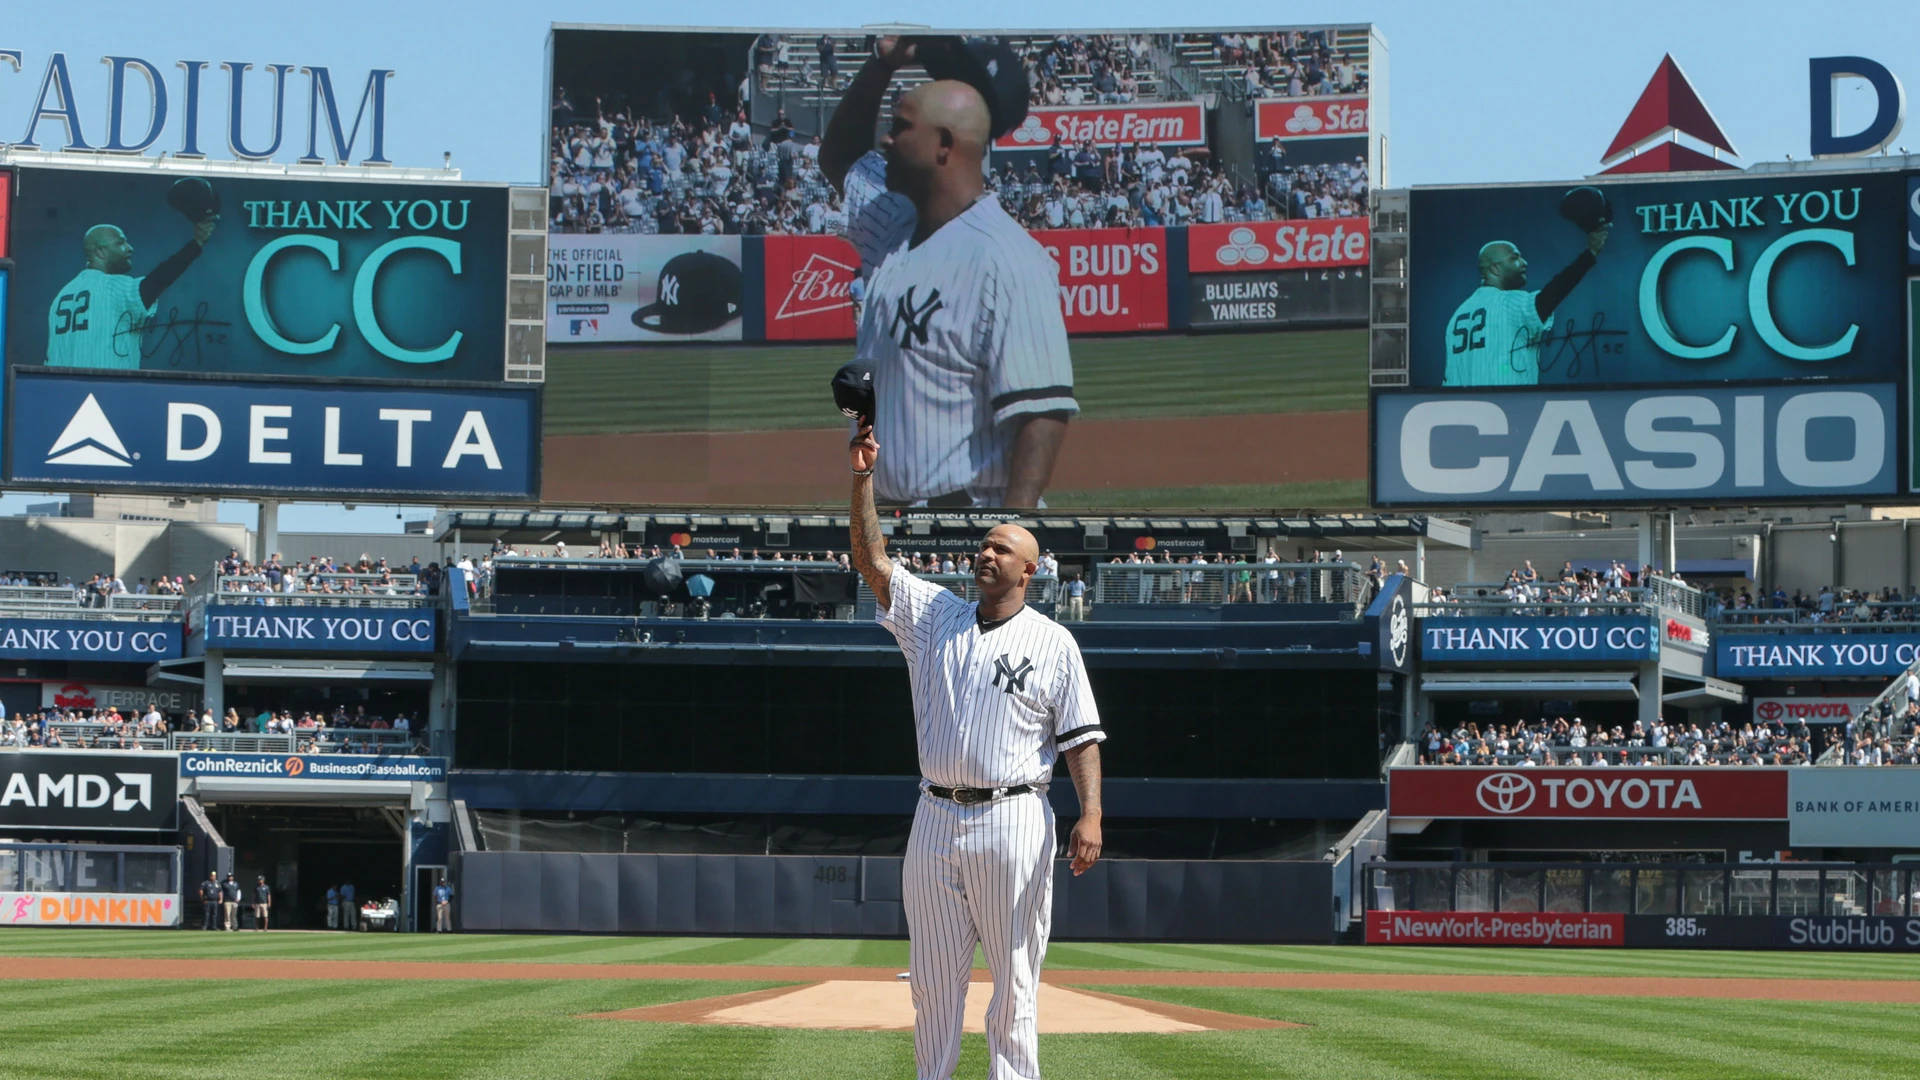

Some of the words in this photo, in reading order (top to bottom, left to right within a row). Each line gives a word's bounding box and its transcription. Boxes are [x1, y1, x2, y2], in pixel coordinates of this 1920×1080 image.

[1325, 104, 1369, 131] Sta
[243, 200, 371, 230] THANK
[379, 200, 471, 230] YOU
[1636, 196, 1764, 233] THANK
[1774, 188, 1862, 223] YOU
[573, 249, 622, 261] OFFICIAL
[1273, 225, 1365, 263] State
[1070, 242, 1159, 277] BUD'S
[243, 234, 463, 363] CC
[550, 285, 573, 297] CAP
[577, 285, 590, 297] OF
[1206, 281, 1279, 300] BLUEJAYS
[1638, 228, 1860, 361] CC
[55, 289, 91, 335] 52
[1211, 302, 1277, 321] YANKEES
[1452, 307, 1487, 355] 52
[166, 402, 502, 470] DELTA
[1400, 391, 1885, 493] CASIO
[889, 538, 936, 546] mastercard
[1157, 539, 1204, 547] mastercard
[0, 628, 60, 650] ANK
[67, 630, 124, 651] YOU
[131, 632, 167, 652] CC
[212, 616, 315, 638] THANK
[322, 618, 384, 640] YOU
[391, 619, 430, 641] CC
[1427, 628, 1529, 650] THANK
[1536, 627, 1598, 650] YOU
[1607, 627, 1645, 649] CC
[1730, 645, 1824, 667] THANK
[1831, 644, 1888, 665] YOU
[100, 689, 181, 709] TERRACE
[1786, 704, 1850, 717] TOYOTA
[186, 757, 282, 773] CohnReznick
[309, 763, 442, 776] BusinessOfBaseball.com
[1, 773, 111, 808] AMD
[1541, 778, 1702, 809] TOYOTA
[1795, 801, 1839, 812] BANK
[1844, 801, 1864, 812] OF
[39, 897, 172, 923] DUNKIN'
[1789, 918, 1894, 945] StubHub
